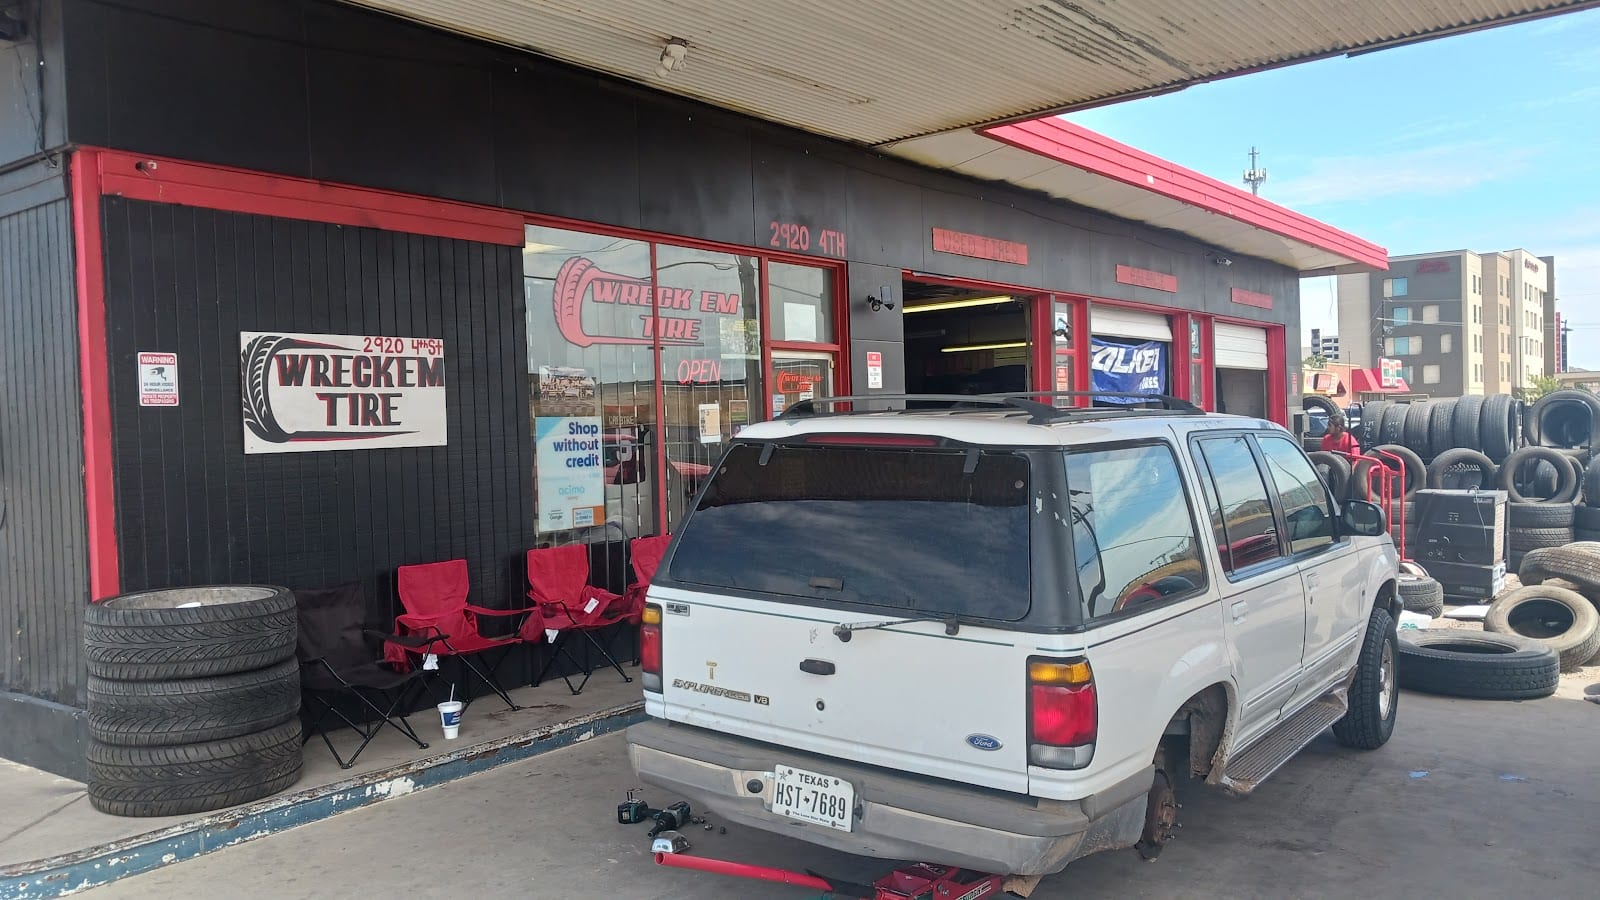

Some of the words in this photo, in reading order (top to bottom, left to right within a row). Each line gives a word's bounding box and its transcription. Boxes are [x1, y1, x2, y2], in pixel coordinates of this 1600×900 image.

[770, 221, 810, 251] 2920
[818, 229, 845, 257] 4TH
[943, 230, 975, 255] USED
[592, 279, 693, 311] WRECK
[700, 291, 740, 315] EM
[640, 315, 702, 341] TIRE
[363, 337, 404, 353] 2920
[141, 355, 175, 364] WARNING
[677, 359, 721, 385] OPEN
[1092, 345, 1160, 374] ALKE
[315, 393, 403, 426] TIRE
[568, 421, 599, 437] Shop
[553, 438, 599, 452] without
[566, 453, 600, 468] credit
[672, 679, 729, 698] EXPLORER
[754, 695, 770, 705] V8
[799, 773, 829, 788] TEXAS
